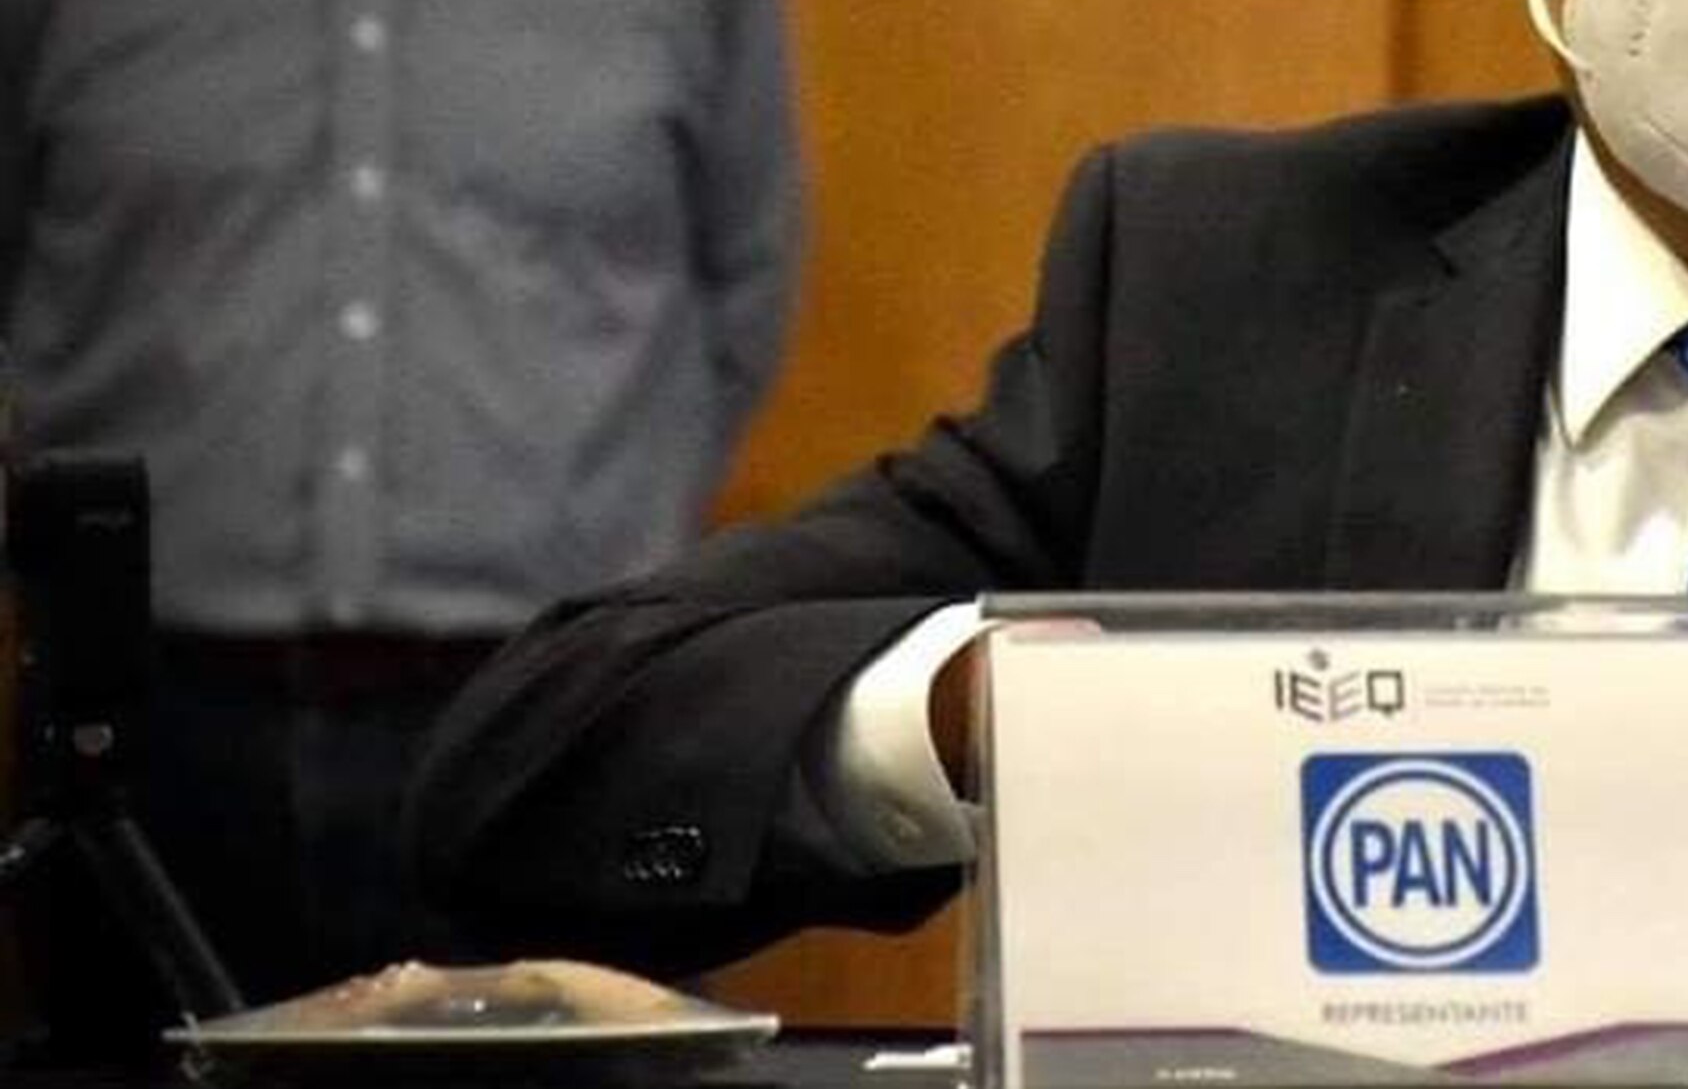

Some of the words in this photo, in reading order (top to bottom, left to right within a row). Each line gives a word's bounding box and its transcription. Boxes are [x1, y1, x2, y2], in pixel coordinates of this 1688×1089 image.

[1274, 669, 1405, 722] IEEQ
[1351, 819, 1491, 908] PAN
[1322, 1002, 1528, 1023] REPRESENTANTE
